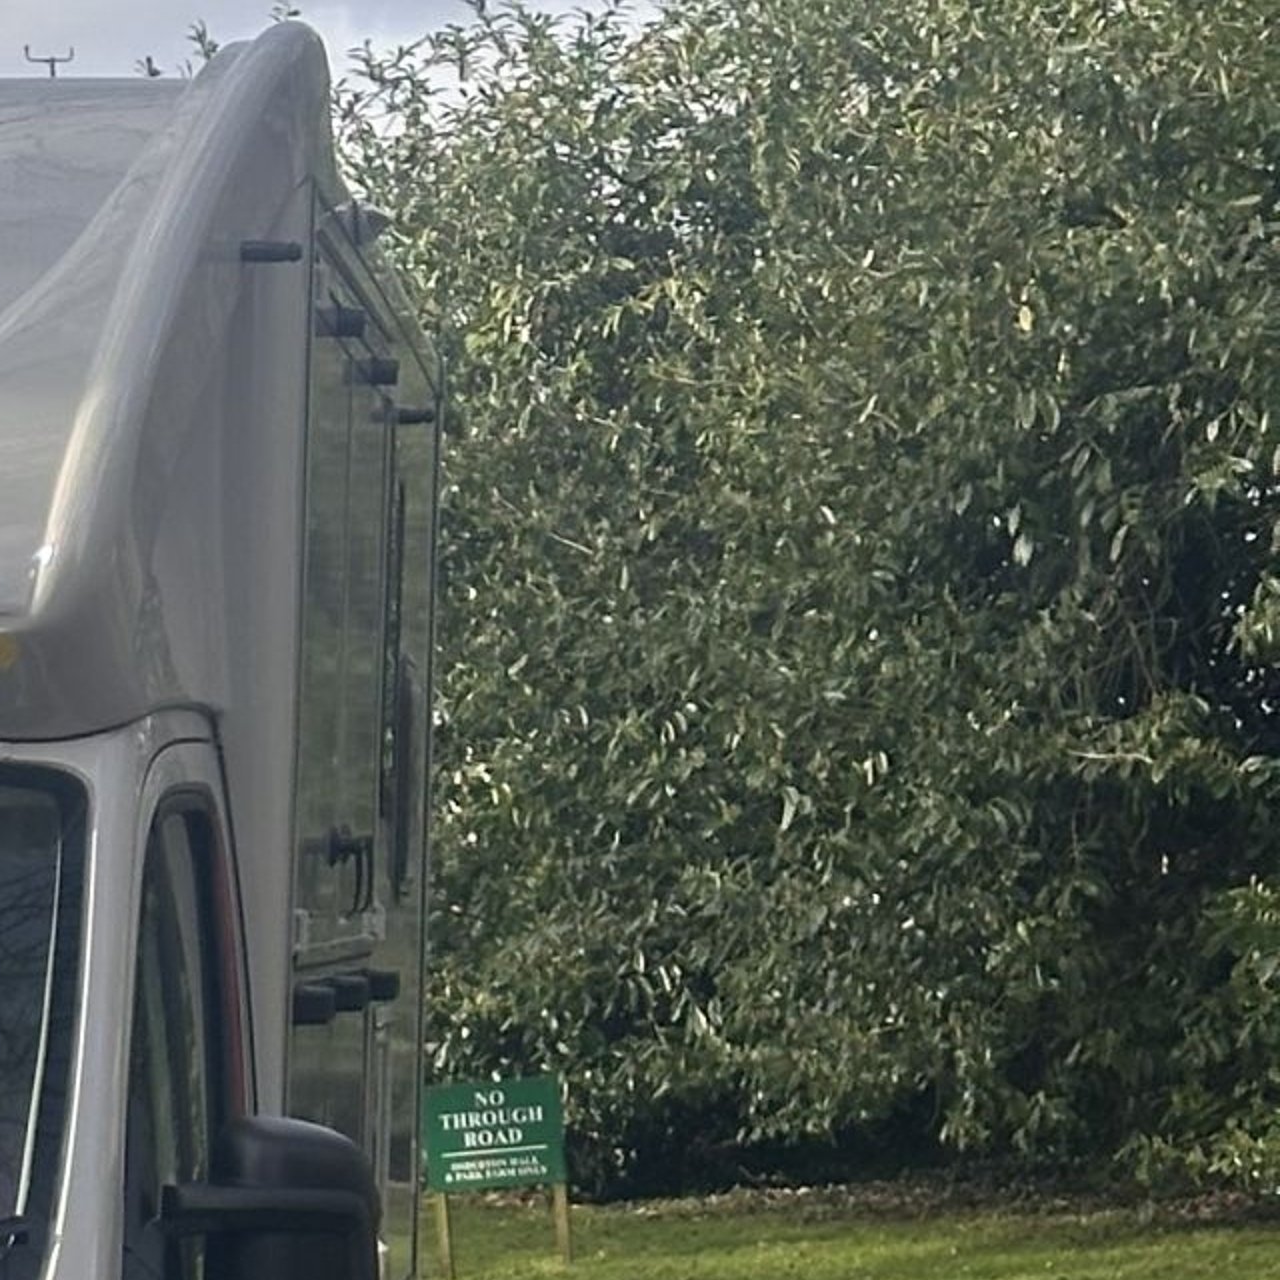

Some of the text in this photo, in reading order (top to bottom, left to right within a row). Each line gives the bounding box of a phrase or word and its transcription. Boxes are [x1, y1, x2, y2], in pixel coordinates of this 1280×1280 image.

[473, 1089, 505, 1108] NO
[438, 1105, 544, 1131] THROUGH
[463, 1127, 523, 1148] ROAD
